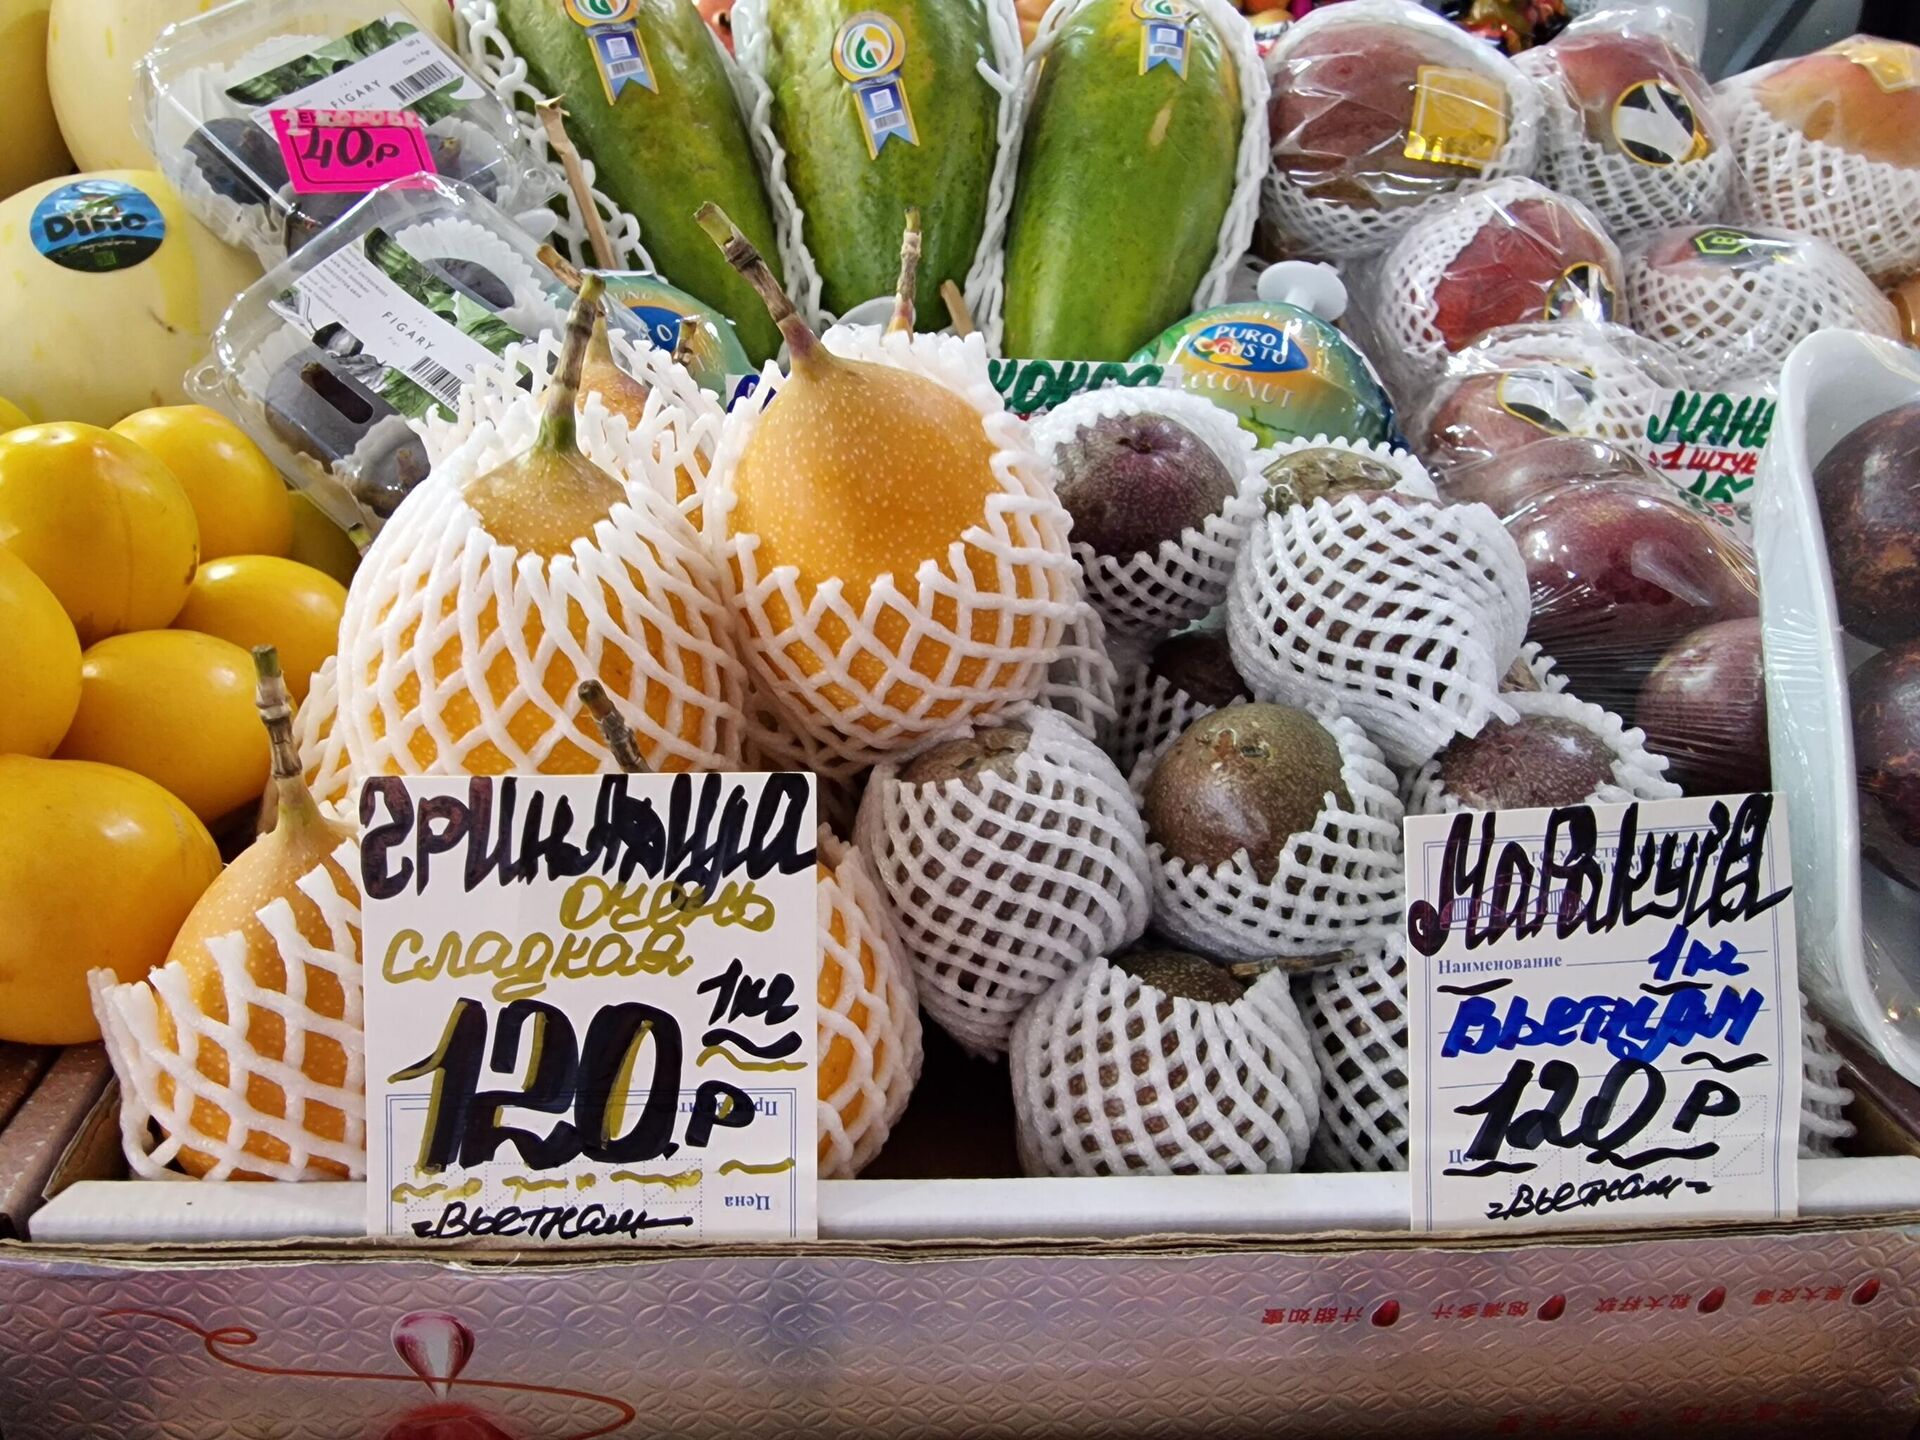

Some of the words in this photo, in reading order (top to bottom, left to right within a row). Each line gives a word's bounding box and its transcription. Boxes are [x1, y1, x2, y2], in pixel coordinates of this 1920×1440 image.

[330, 79, 381, 109] FIGARY
[43, 213, 146, 242] Dino
[381, 311, 436, 351] FIGARY
[1213, 325, 1278, 346] PURO
[1218, 340, 1288, 365] GUSTO
[1438, 955, 1563, 975] Наименование
[724, 1193, 770, 1211] Цена
[1261, 1305, 1365, 1326] 汁甜如蜜
